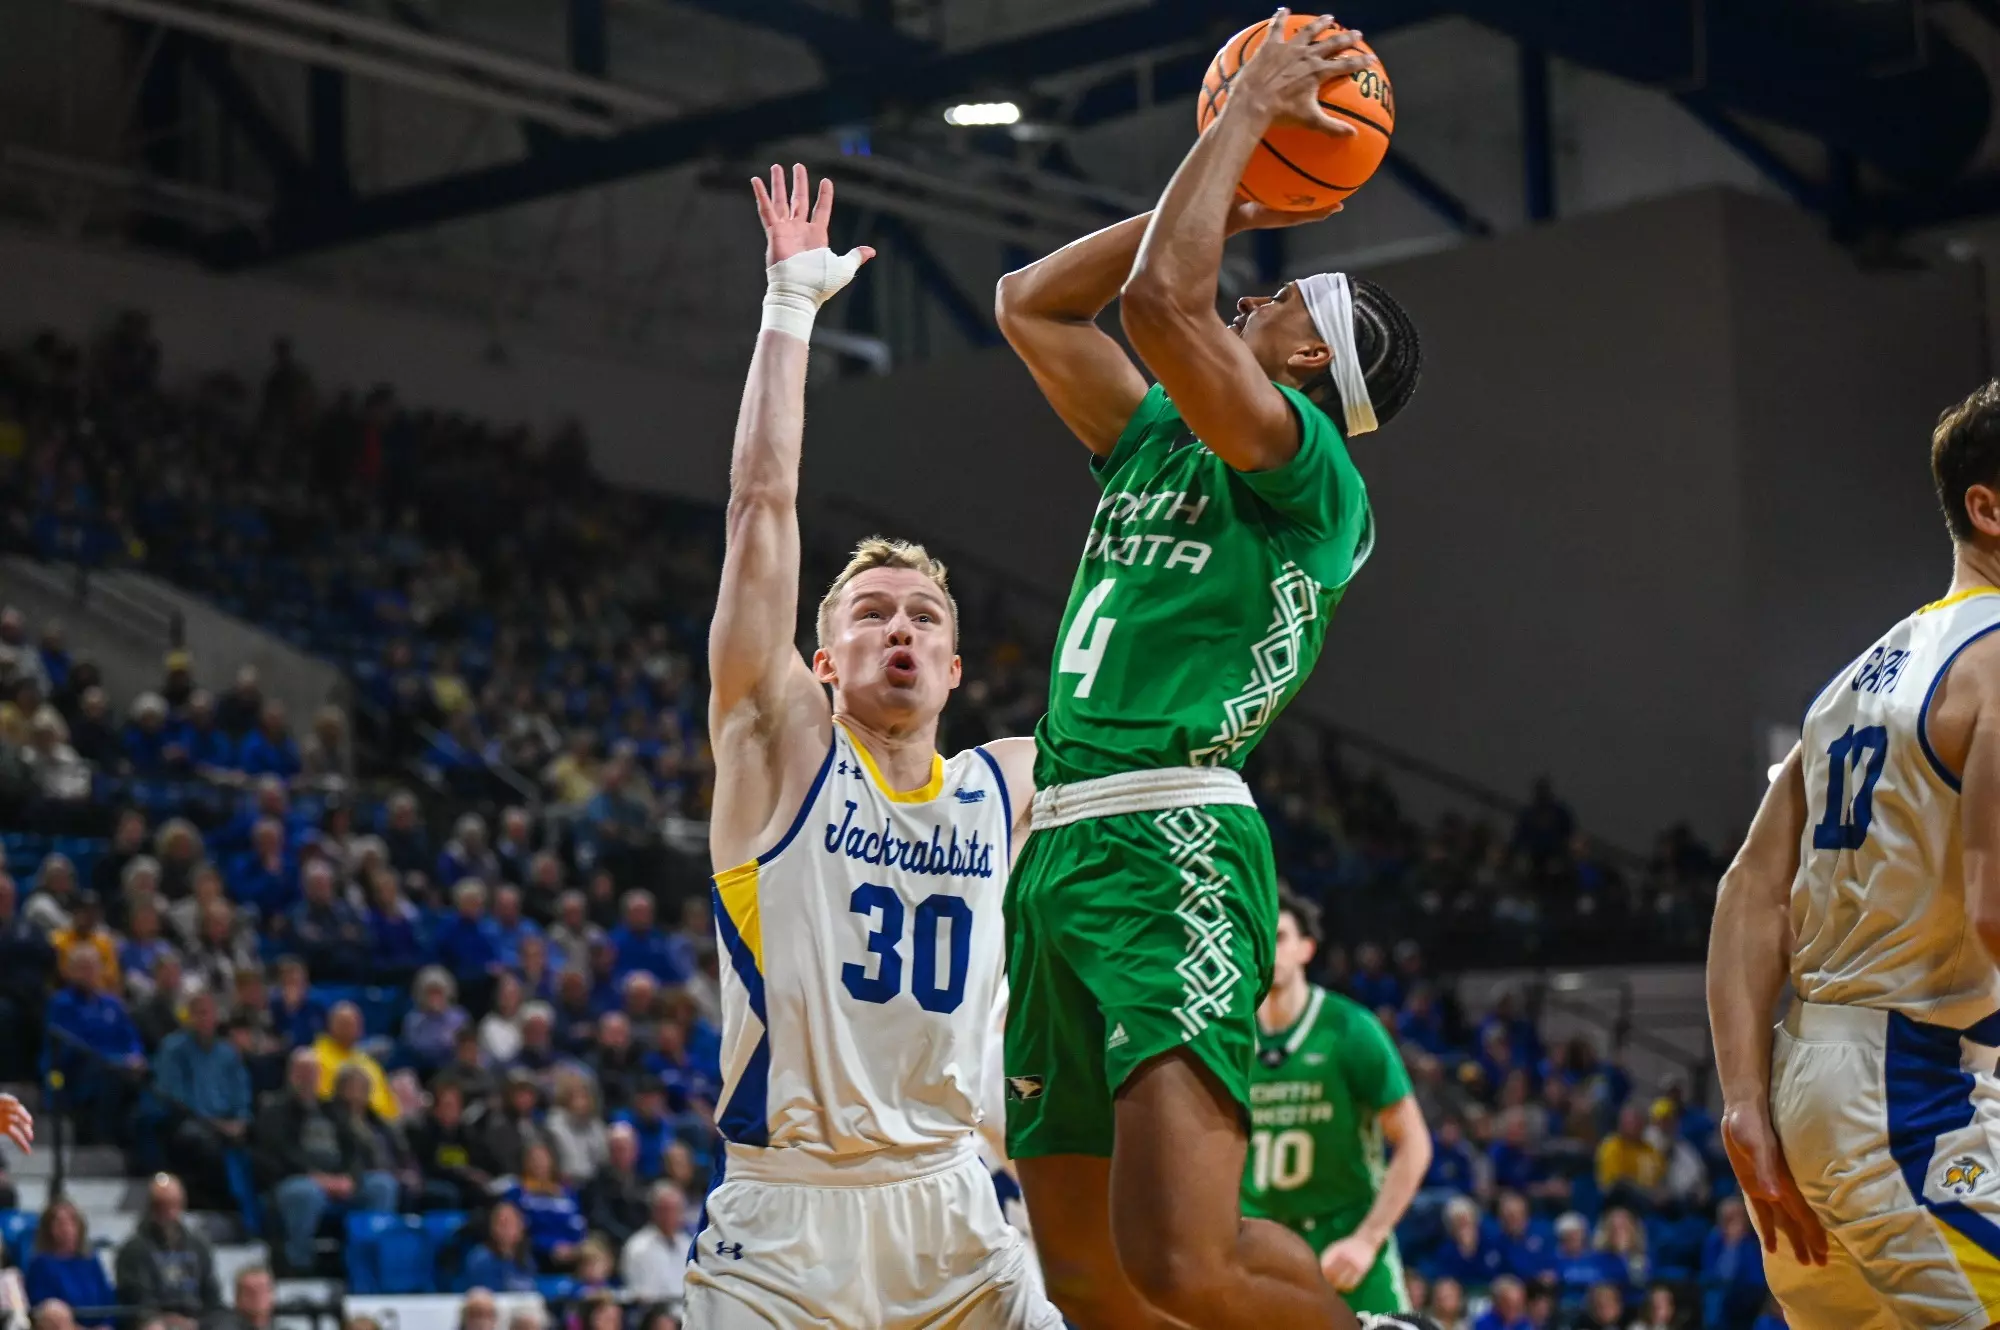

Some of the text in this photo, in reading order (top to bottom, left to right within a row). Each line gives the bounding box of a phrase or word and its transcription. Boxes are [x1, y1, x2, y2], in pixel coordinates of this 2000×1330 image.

[1058, 578, 1117, 699] 4
[824, 799, 994, 879] Jackrabbits
[841, 881, 973, 1014] 30
[1252, 1129, 1315, 1191] 10
